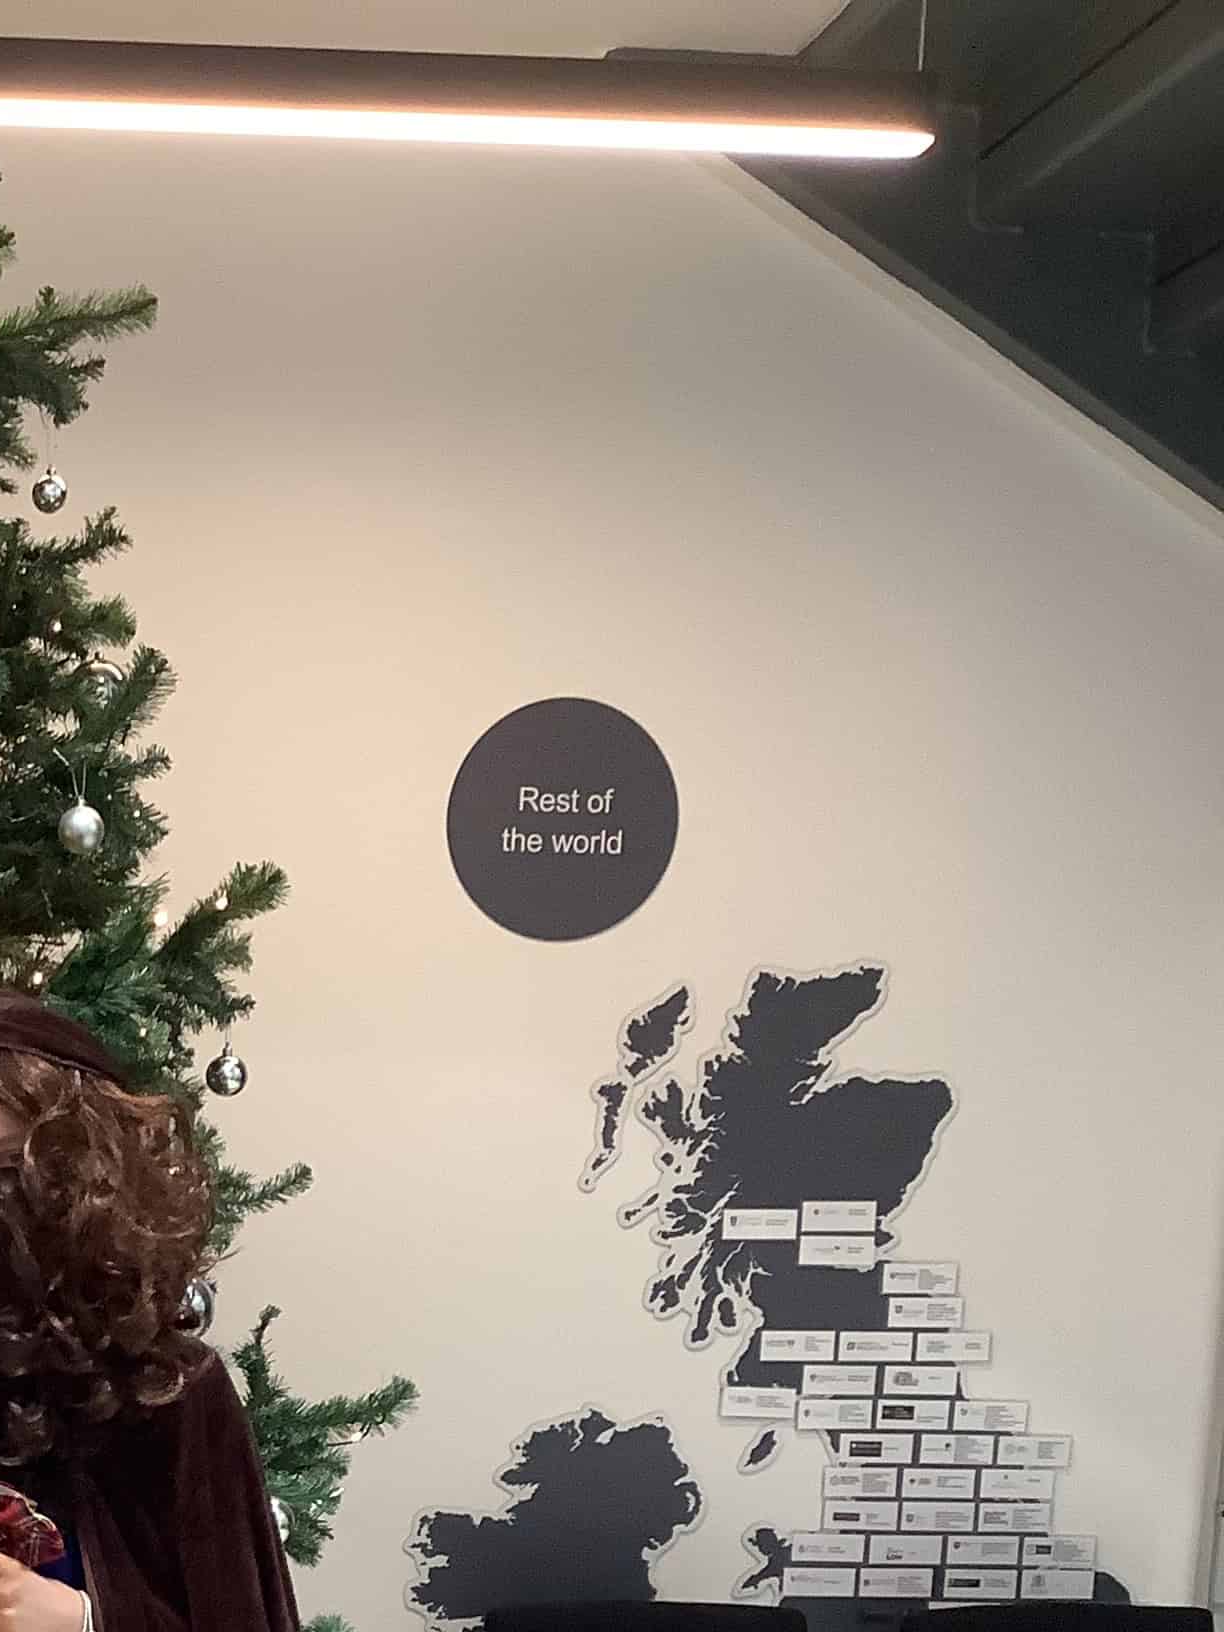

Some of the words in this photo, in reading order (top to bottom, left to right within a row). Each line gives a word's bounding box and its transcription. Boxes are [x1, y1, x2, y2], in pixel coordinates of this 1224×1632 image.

[518, 786, 580, 814] Rest
[586, 787, 615, 815] of
[501, 826, 543, 854] the
[551, 829, 623, 855] world
